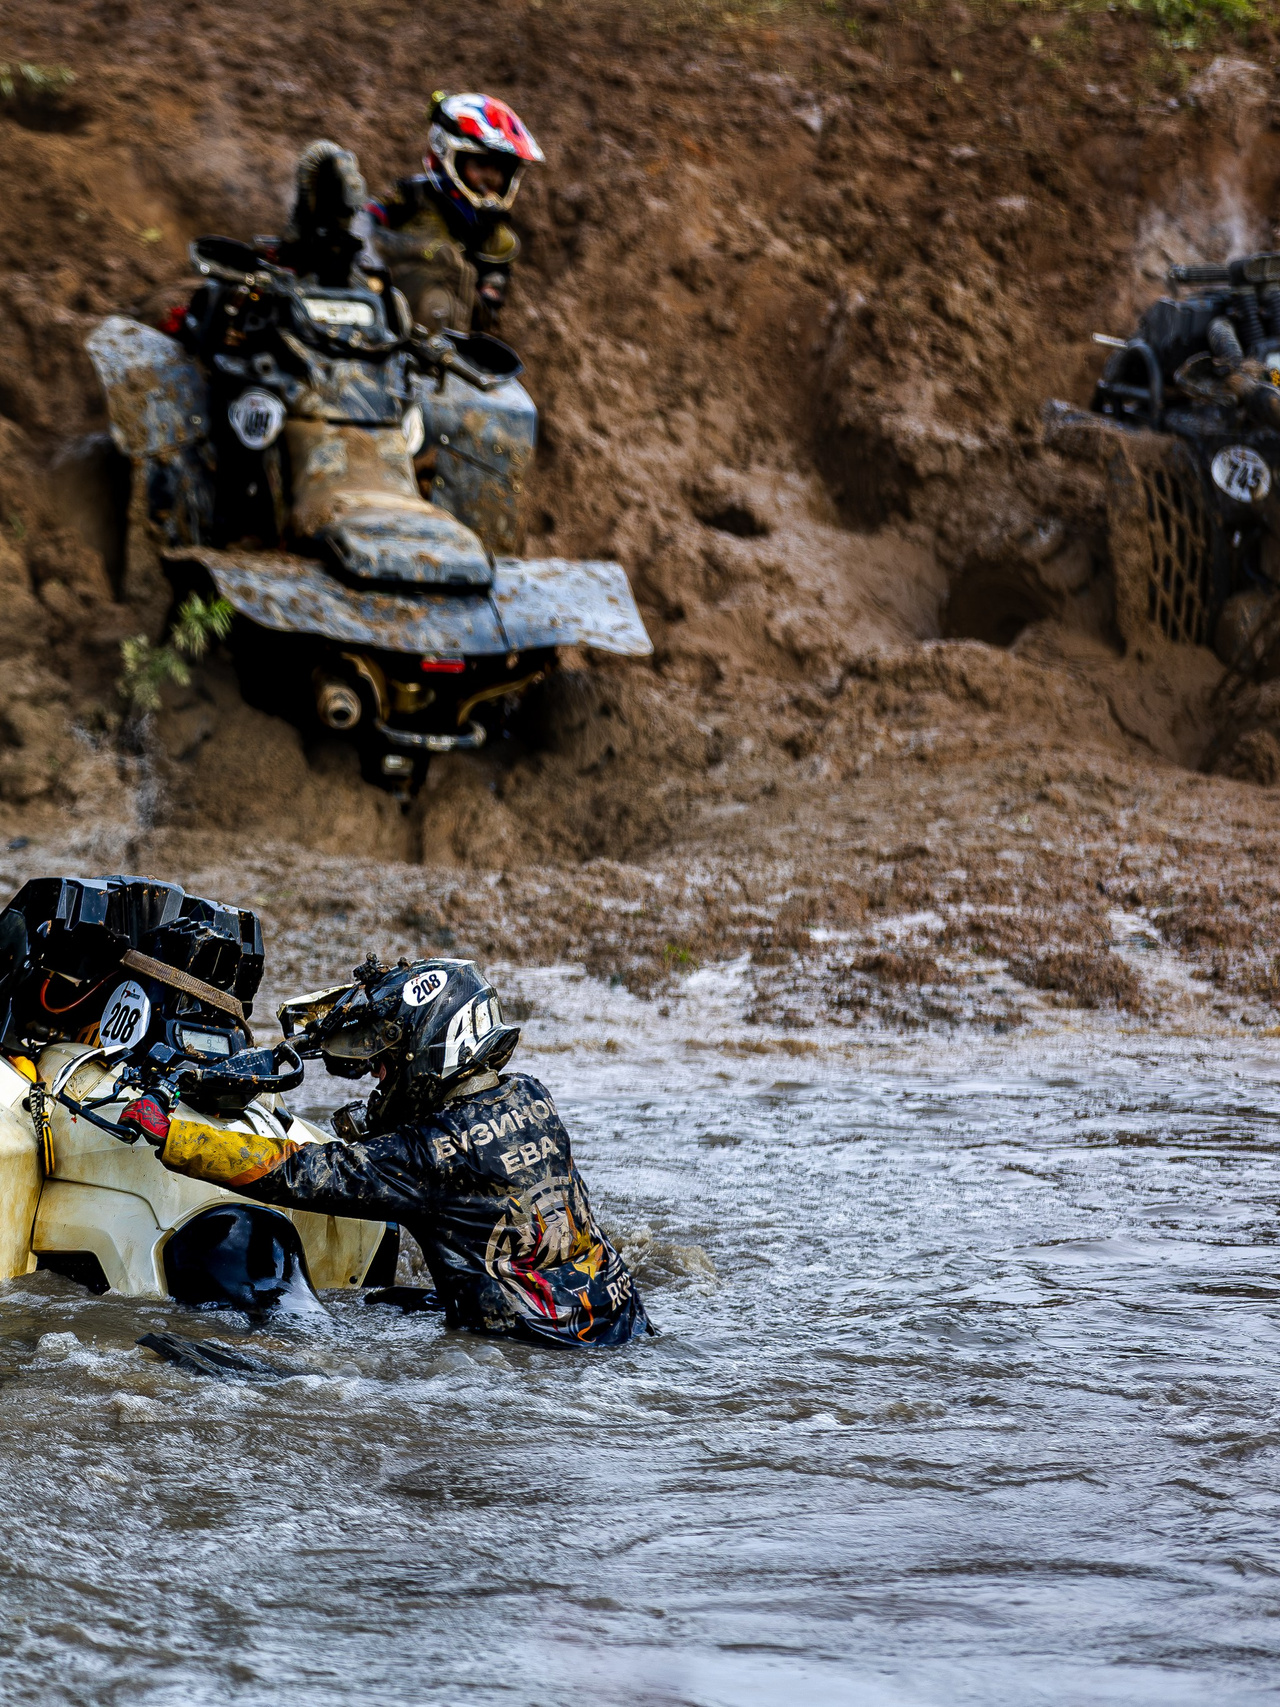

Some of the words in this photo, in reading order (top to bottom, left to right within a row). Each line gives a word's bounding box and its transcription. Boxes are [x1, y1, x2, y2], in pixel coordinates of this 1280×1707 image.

[412, 973, 441, 1004] 208
[101, 1002, 141, 1044] 208
[500, 1135, 560, 1175] ЕВА
